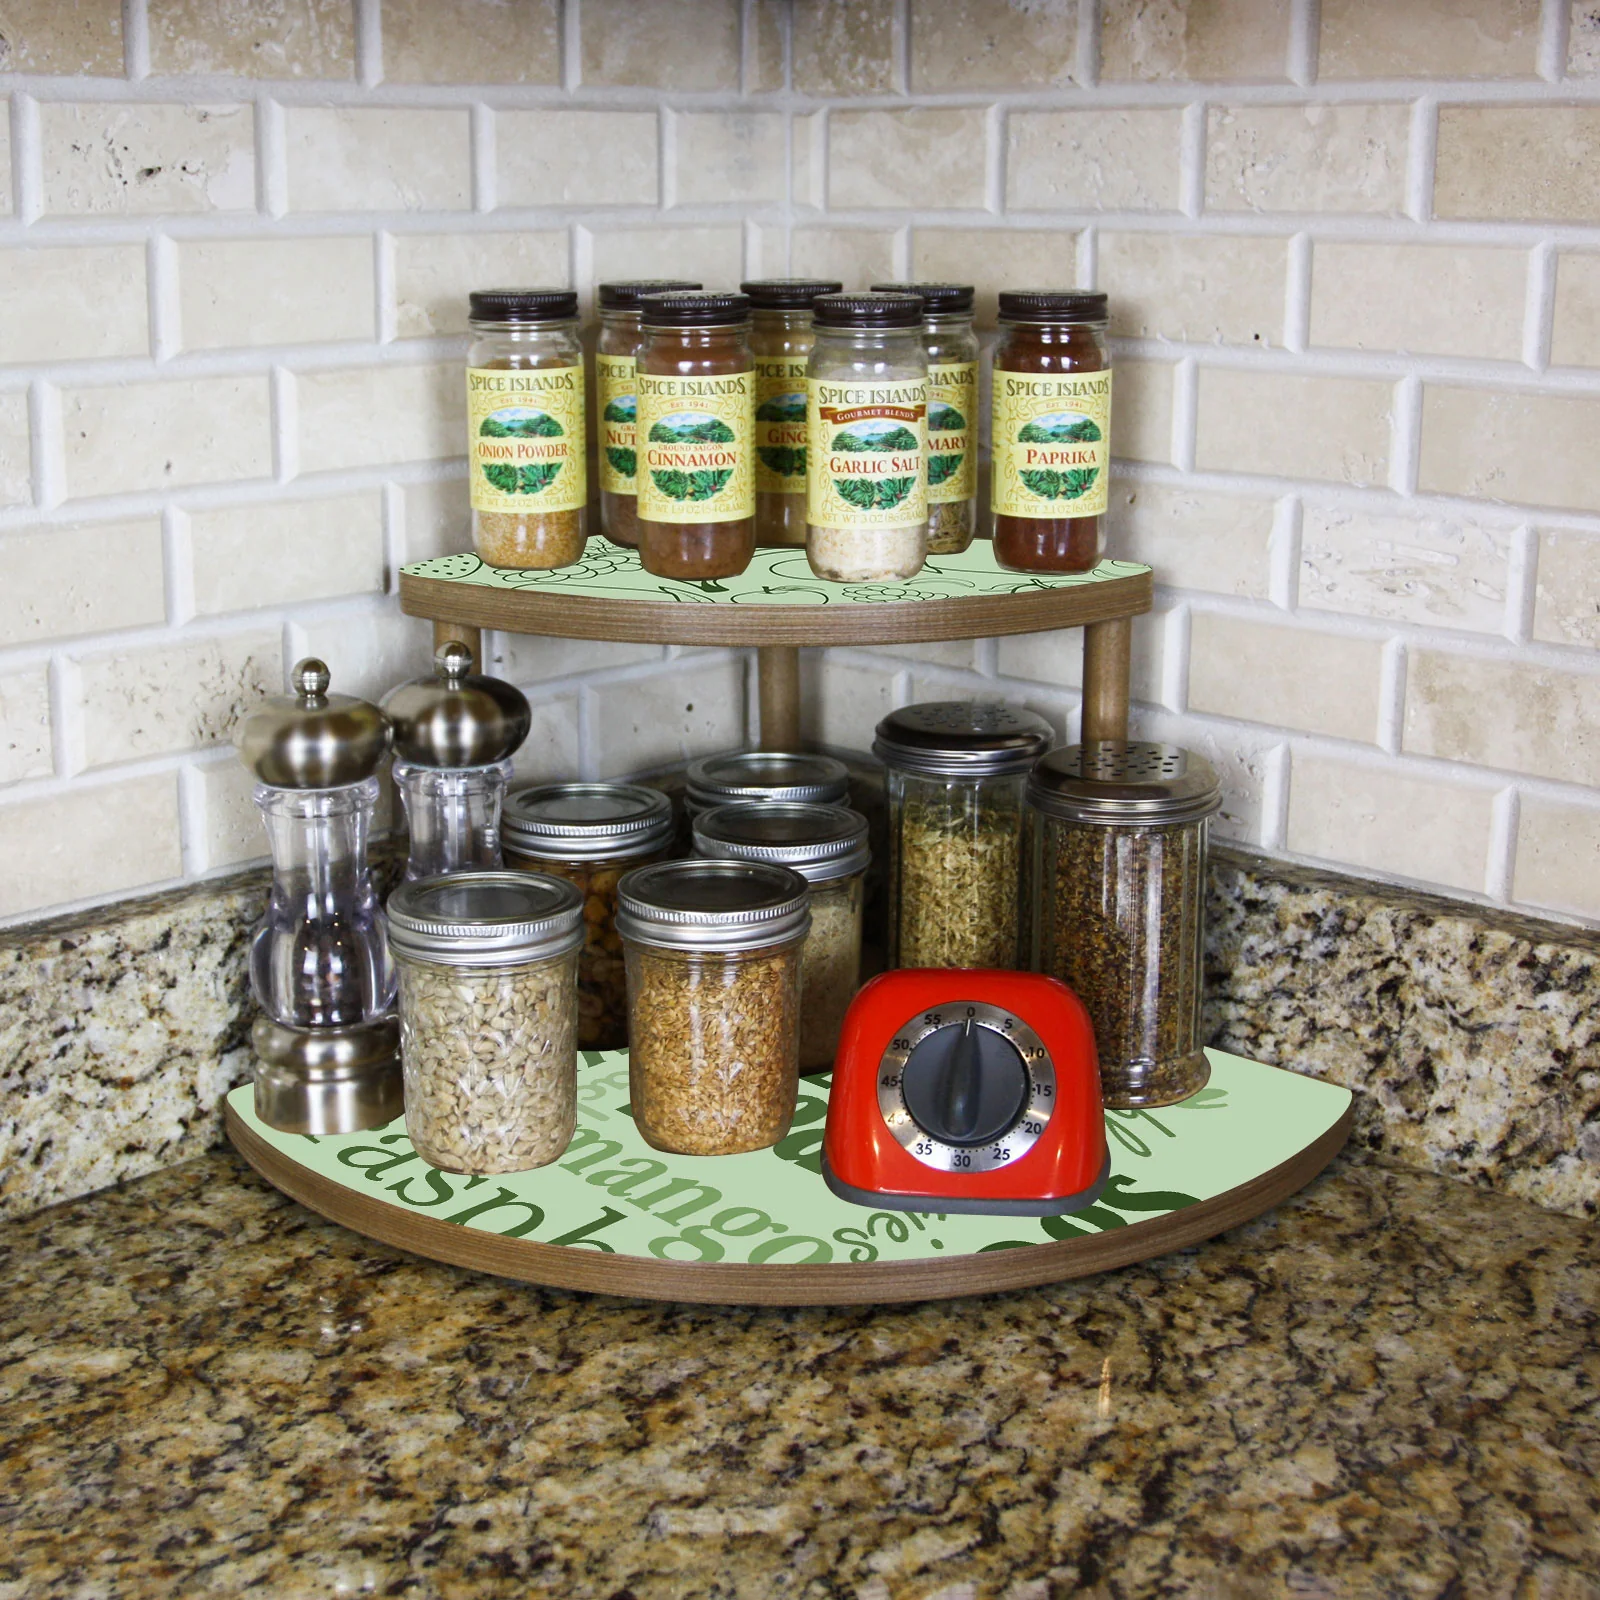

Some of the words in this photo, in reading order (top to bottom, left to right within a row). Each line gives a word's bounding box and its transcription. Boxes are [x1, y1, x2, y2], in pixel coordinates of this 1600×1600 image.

[755, 363, 784, 378] PICE
[469, 373, 505, 391] SPICE
[510, 372, 574, 391] ISLANDS
[639, 376, 676, 396] SPICE
[681, 376, 747, 396] ISLANDS
[1006, 378, 1052, 397] SPICE
[1056, 376, 1109, 396] ISLANDS
[819, 386, 866, 405] SPICE
[870, 383, 927, 404] ISLANDS
[836, 408, 882, 421] GOURMET
[885, 408, 915, 419] BLENDS
[478, 442, 513, 459] ONION
[517, 442, 569, 459] POWDER
[658, 444, 692, 452] GROUND
[694, 443, 724, 452] SAIGON
[648, 449, 737, 467] CINNAMON
[1026, 449, 1097, 465] PAPRIKA
[829, 456, 888, 474] GARLIC
[891, 456, 921, 473] SALT
[966, 1006, 976, 1018] 0
[924, 1014, 941, 1026] 55
[1004, 1018, 1013, 1029] 5
[892, 1039, 909, 1051] 50
[1029, 1046, 1045, 1058] 10
[881, 1075, 898, 1087] 45
[1035, 1083, 1052, 1097] 15
[887, 1112, 905, 1125] 40
[1024, 1122, 1042, 1135] 20
[915, 1143, 932, 1156] 35
[993, 1148, 1010, 1161] 25
[953, 1154, 971, 1168] 30
